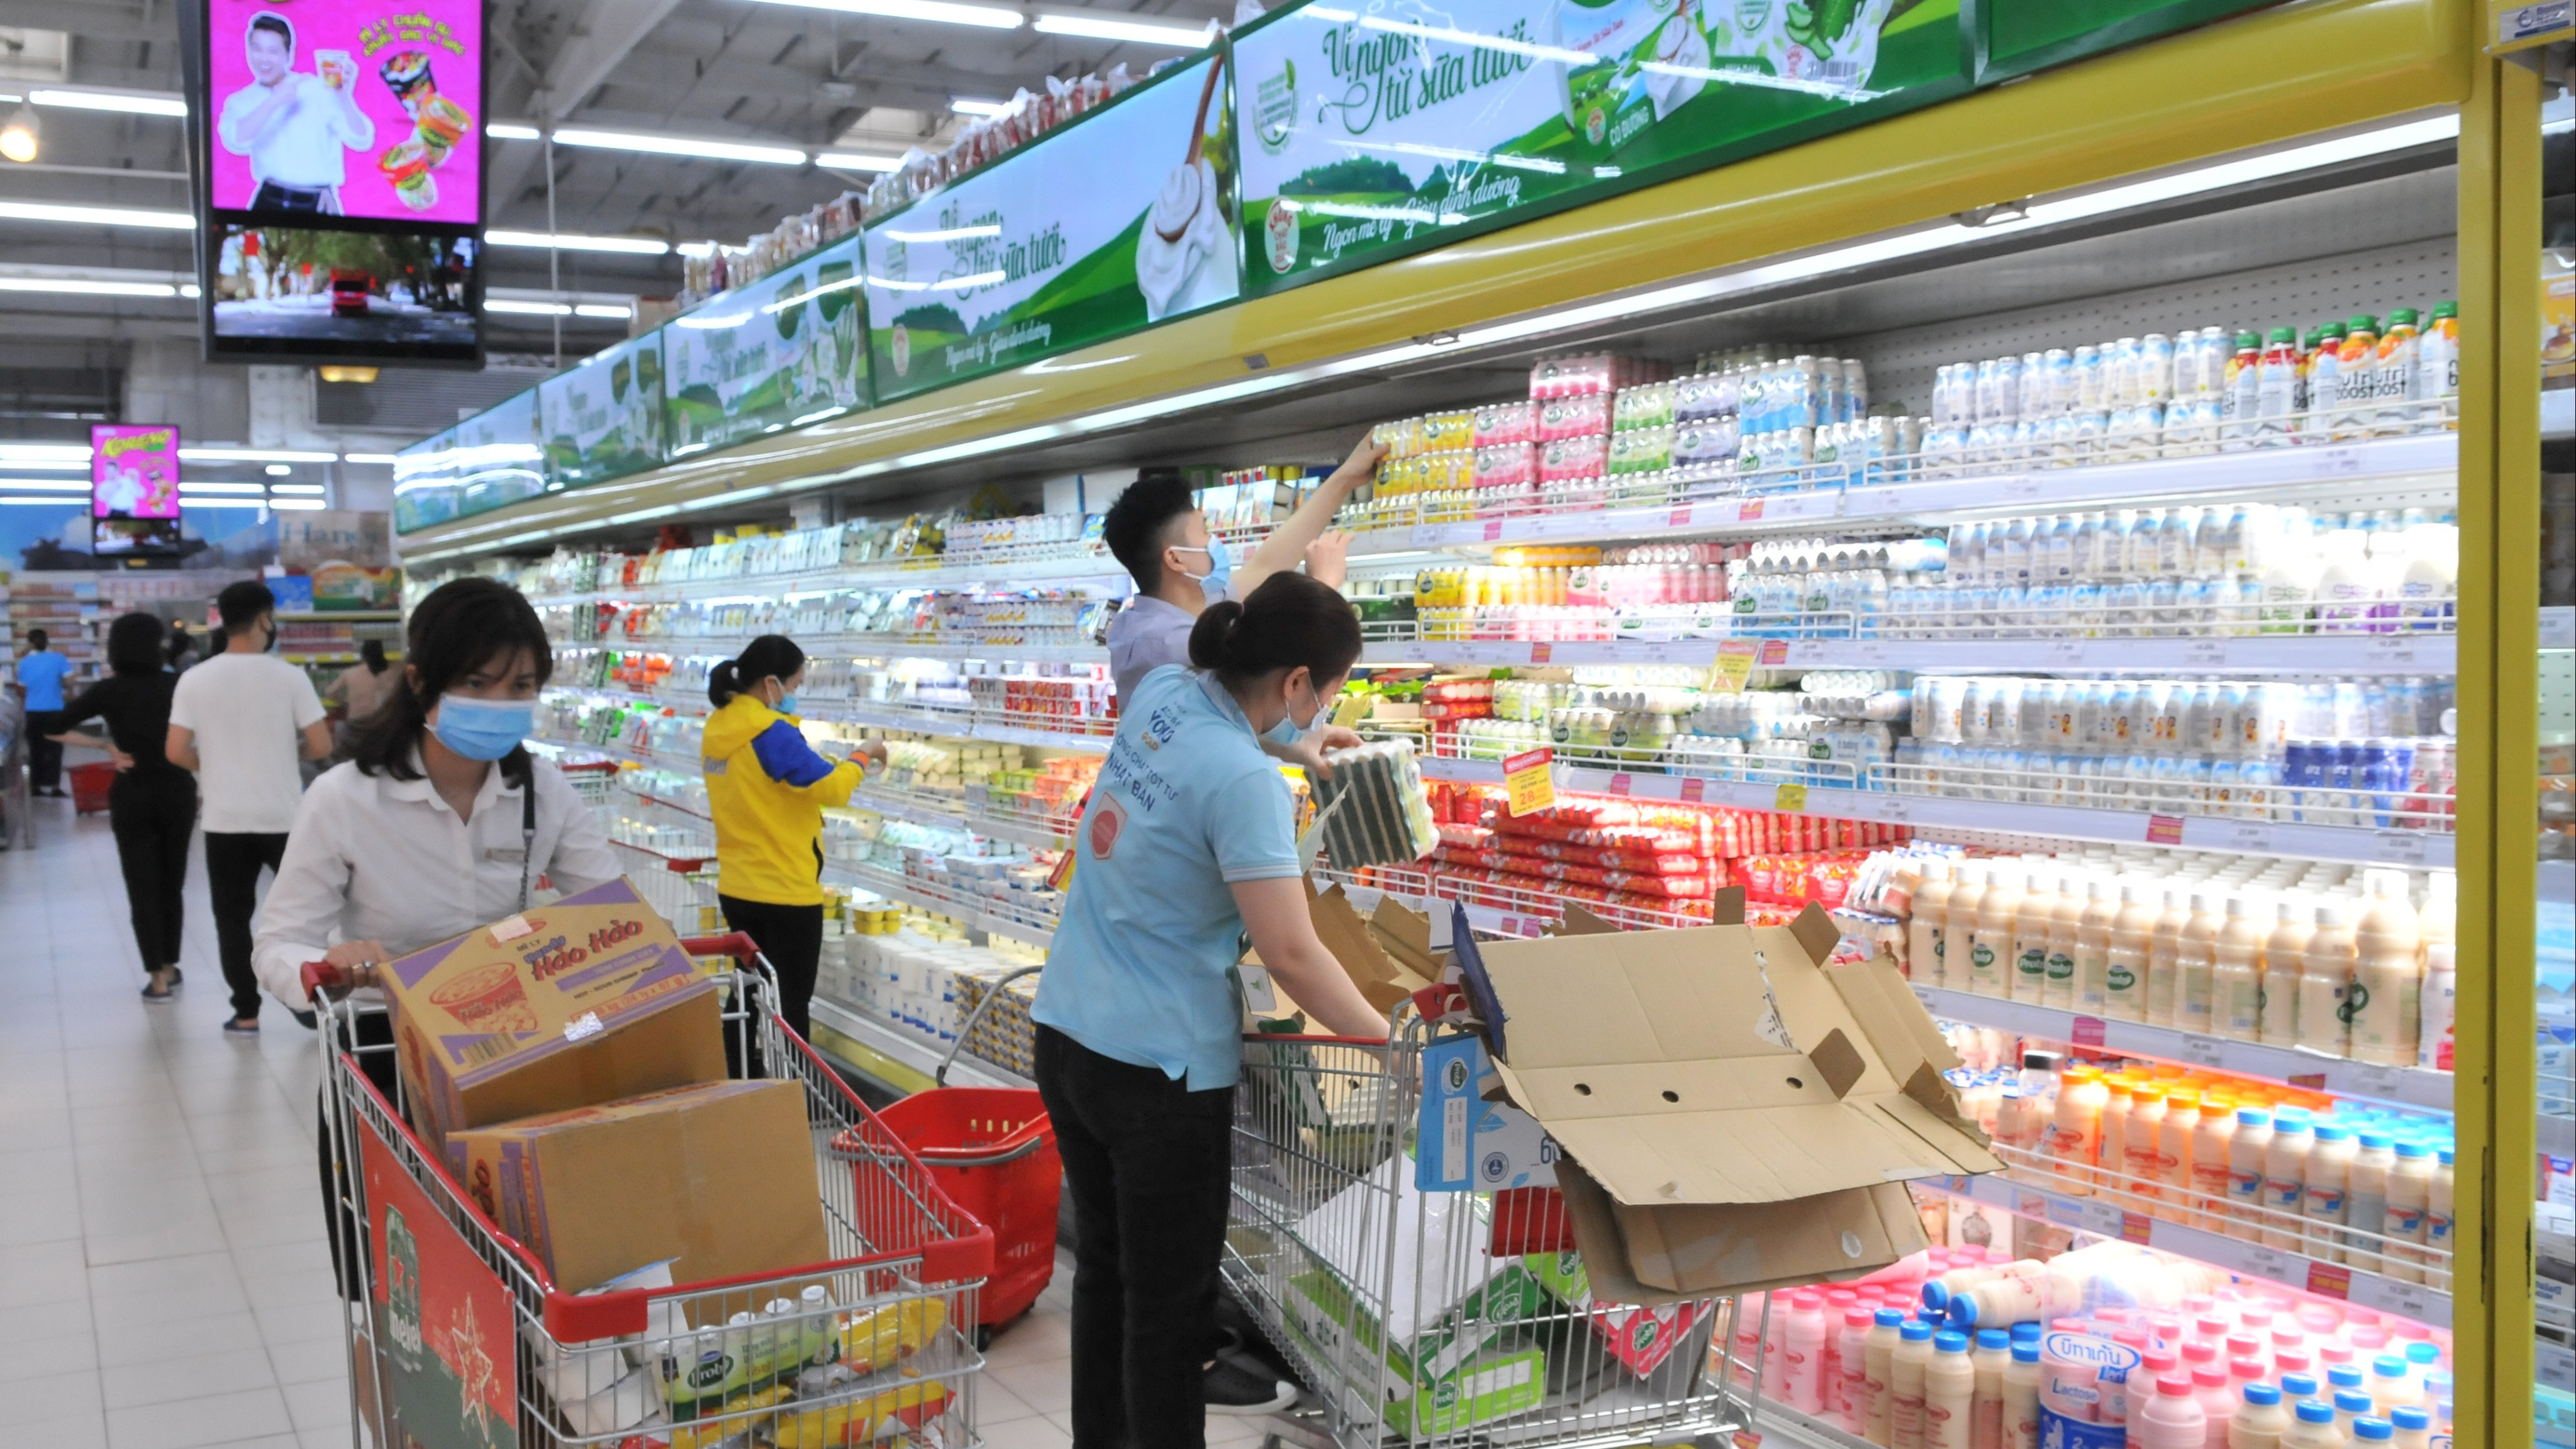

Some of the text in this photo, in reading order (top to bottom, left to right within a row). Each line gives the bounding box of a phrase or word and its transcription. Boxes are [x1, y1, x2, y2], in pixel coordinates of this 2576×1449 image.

[1519, 790, 1535, 806] 28
[531, 946, 588, 982] Hảo
[588, 919, 644, 954] Hảo
[2052, 1377, 2100, 1402] Lactose
